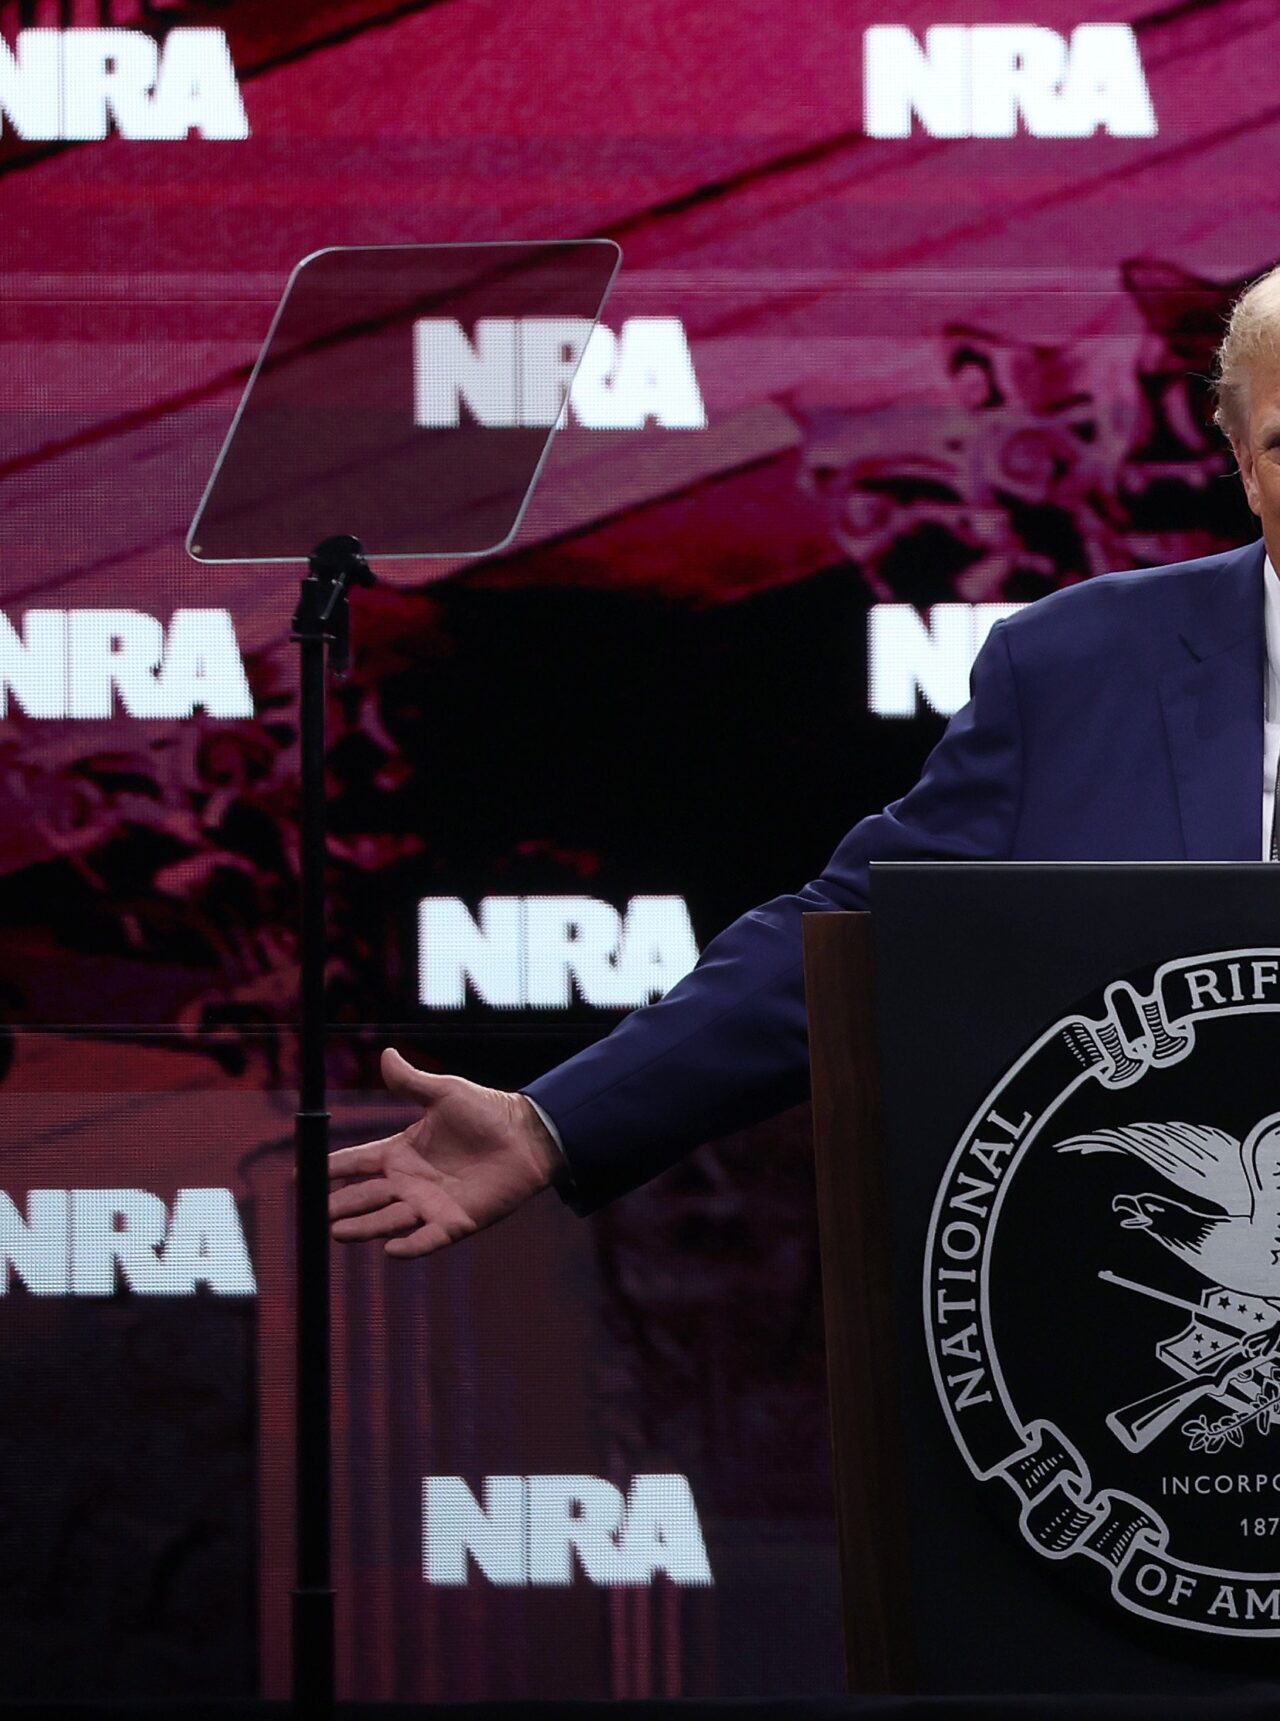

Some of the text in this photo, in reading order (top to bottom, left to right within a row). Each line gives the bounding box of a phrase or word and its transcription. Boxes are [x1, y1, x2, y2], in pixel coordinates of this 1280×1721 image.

[864, 23, 1158, 138] NRA
[412, 317, 708, 430] NRA
[418, 895, 699, 1009] NRA
[0, 1187, 258, 1296] NRA
[938, 1106, 1034, 1411] NATIONAL
[421, 1473, 713, 1586] NRA
[1133, 1562, 1197, 1607] OF
